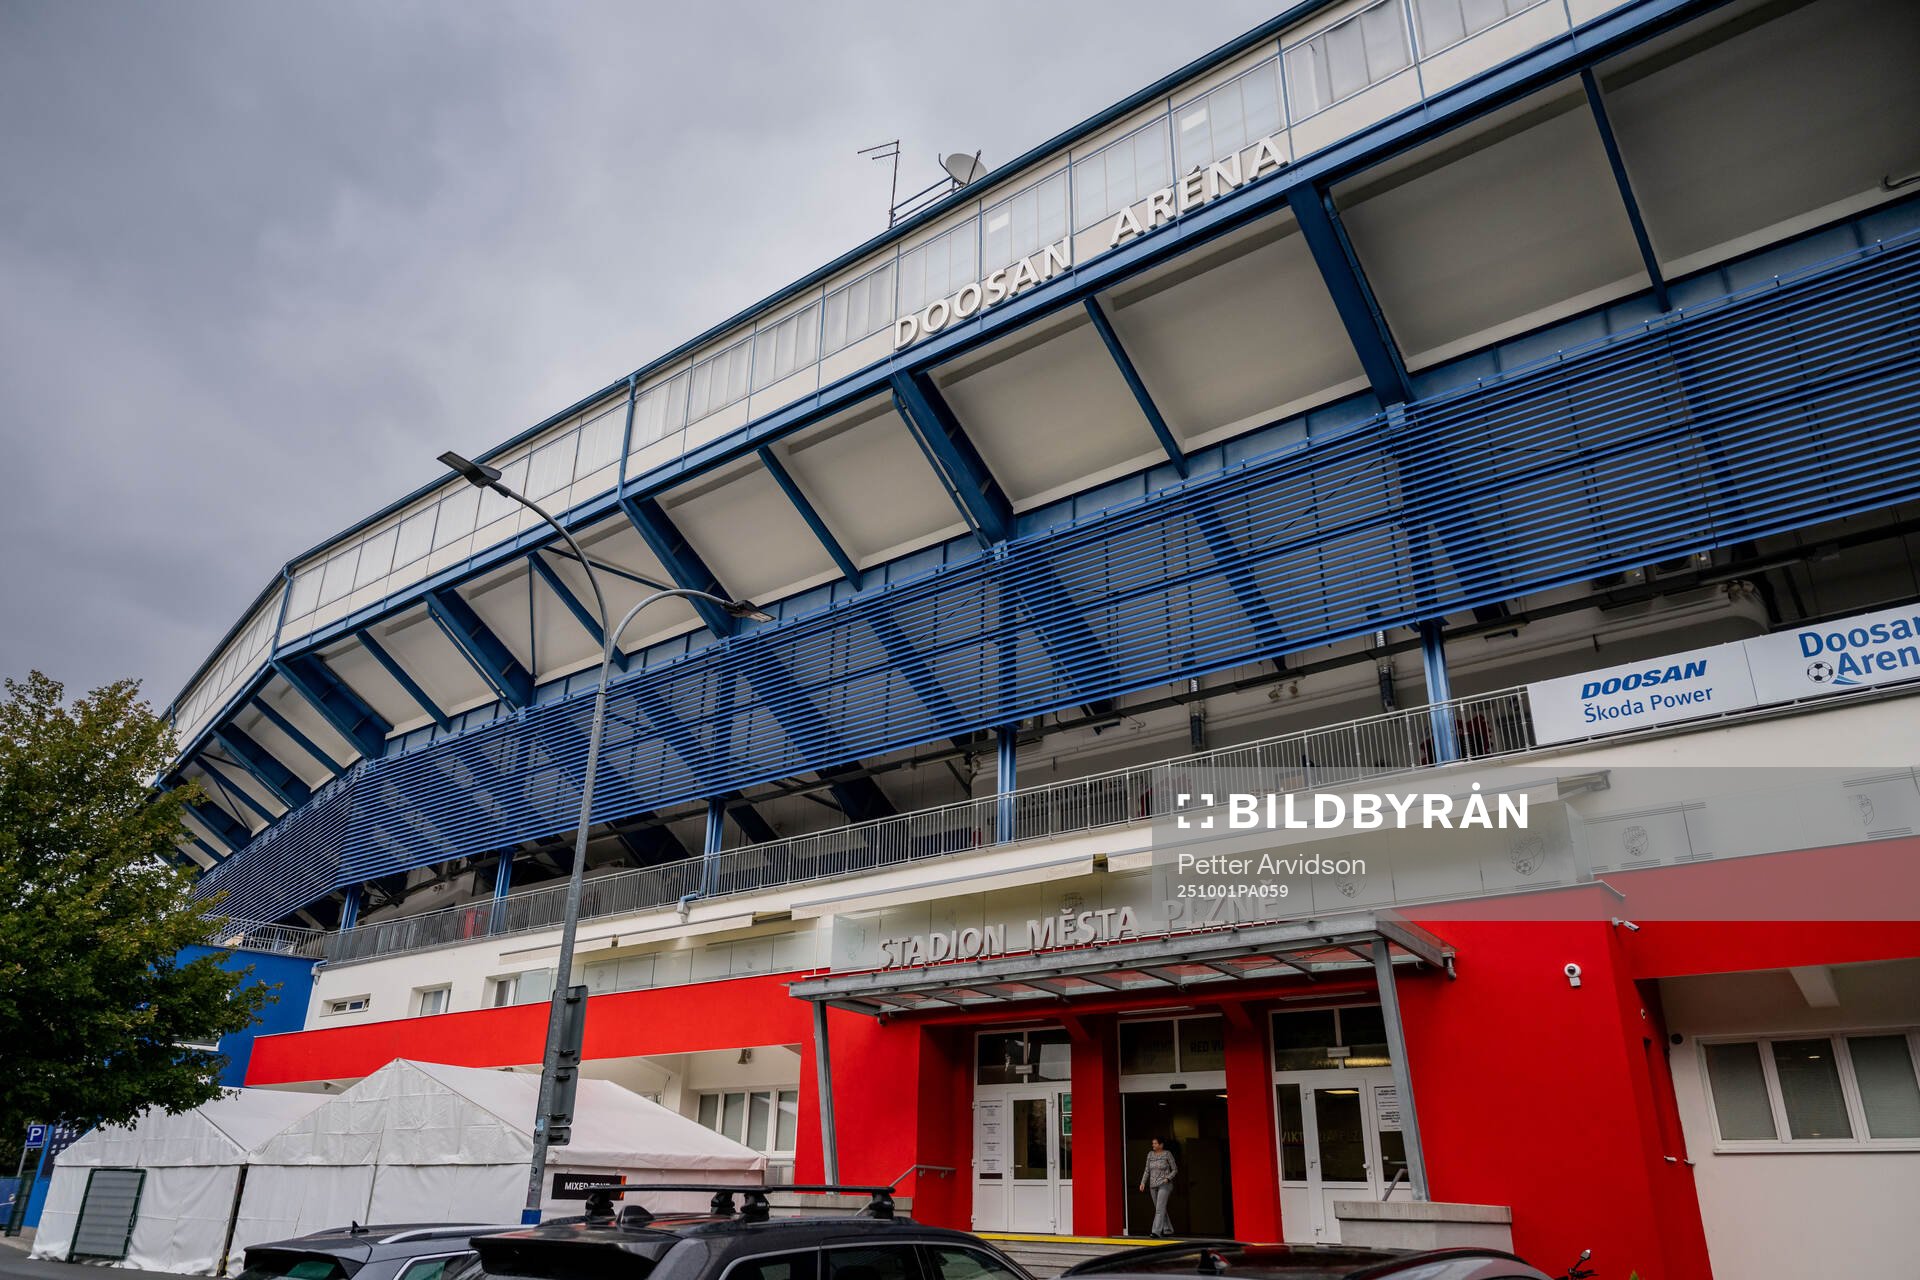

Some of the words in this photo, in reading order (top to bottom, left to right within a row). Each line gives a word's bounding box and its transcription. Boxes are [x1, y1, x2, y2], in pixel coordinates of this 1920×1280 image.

[894, 235, 1073, 351] DOOSAN
[1110, 137, 1289, 249] ARÉNA
[1581, 660, 1707, 700] DOOSAN
[1583, 698, 1645, 724] Škoda
[1650, 686, 1713, 711] Power
[880, 923, 1007, 970] STADION
[1026, 905, 1139, 951] MĚSTA
[30, 1128, 41, 1141] P
[564, 1181, 589, 1191] MIXED
